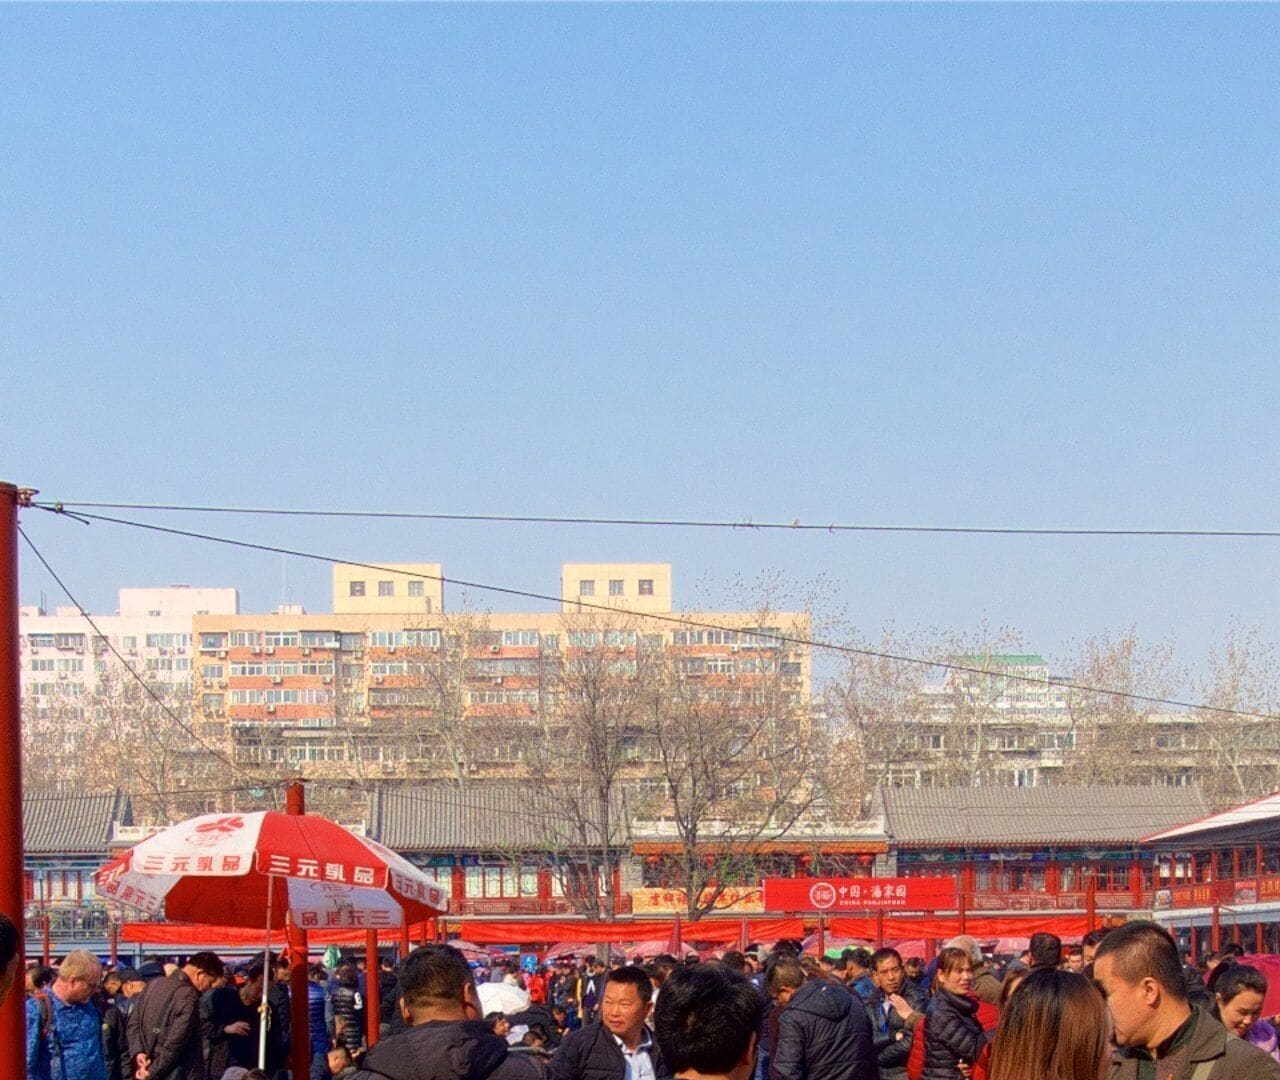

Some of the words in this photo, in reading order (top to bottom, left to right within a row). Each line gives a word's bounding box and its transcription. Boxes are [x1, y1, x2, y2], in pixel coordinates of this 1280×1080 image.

[144, 855, 241, 872] 三元乳品
[270, 854, 374, 885] 三元乳品
